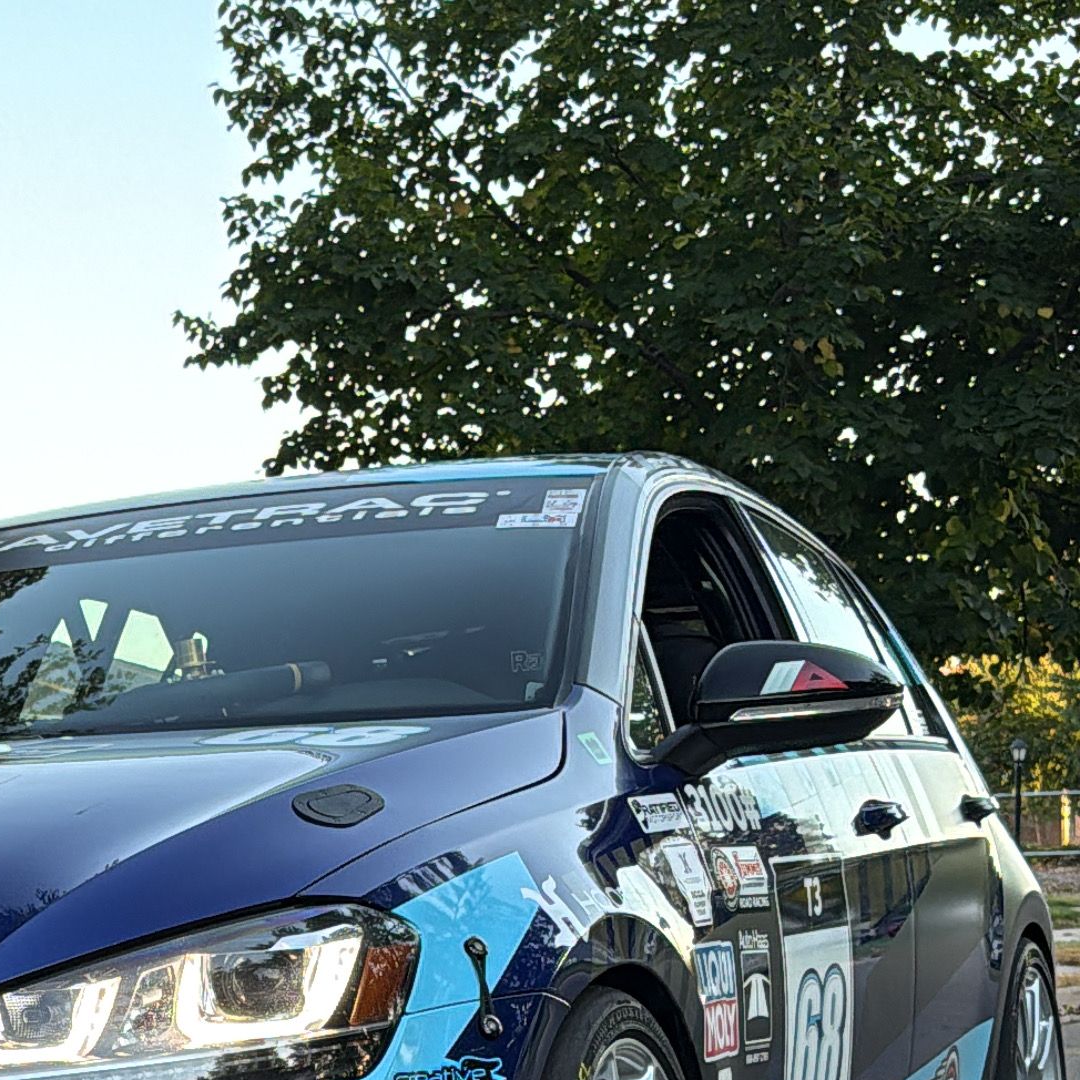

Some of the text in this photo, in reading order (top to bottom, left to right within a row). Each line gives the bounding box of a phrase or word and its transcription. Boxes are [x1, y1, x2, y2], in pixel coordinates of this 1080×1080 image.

[44, 505, 478, 552] differentials
[194, 725, 432, 747] 68
[803, 876, 822, 917] T3
[696, 950, 736, 997] LIQUI
[706, 1003, 736, 1053] MOLY
